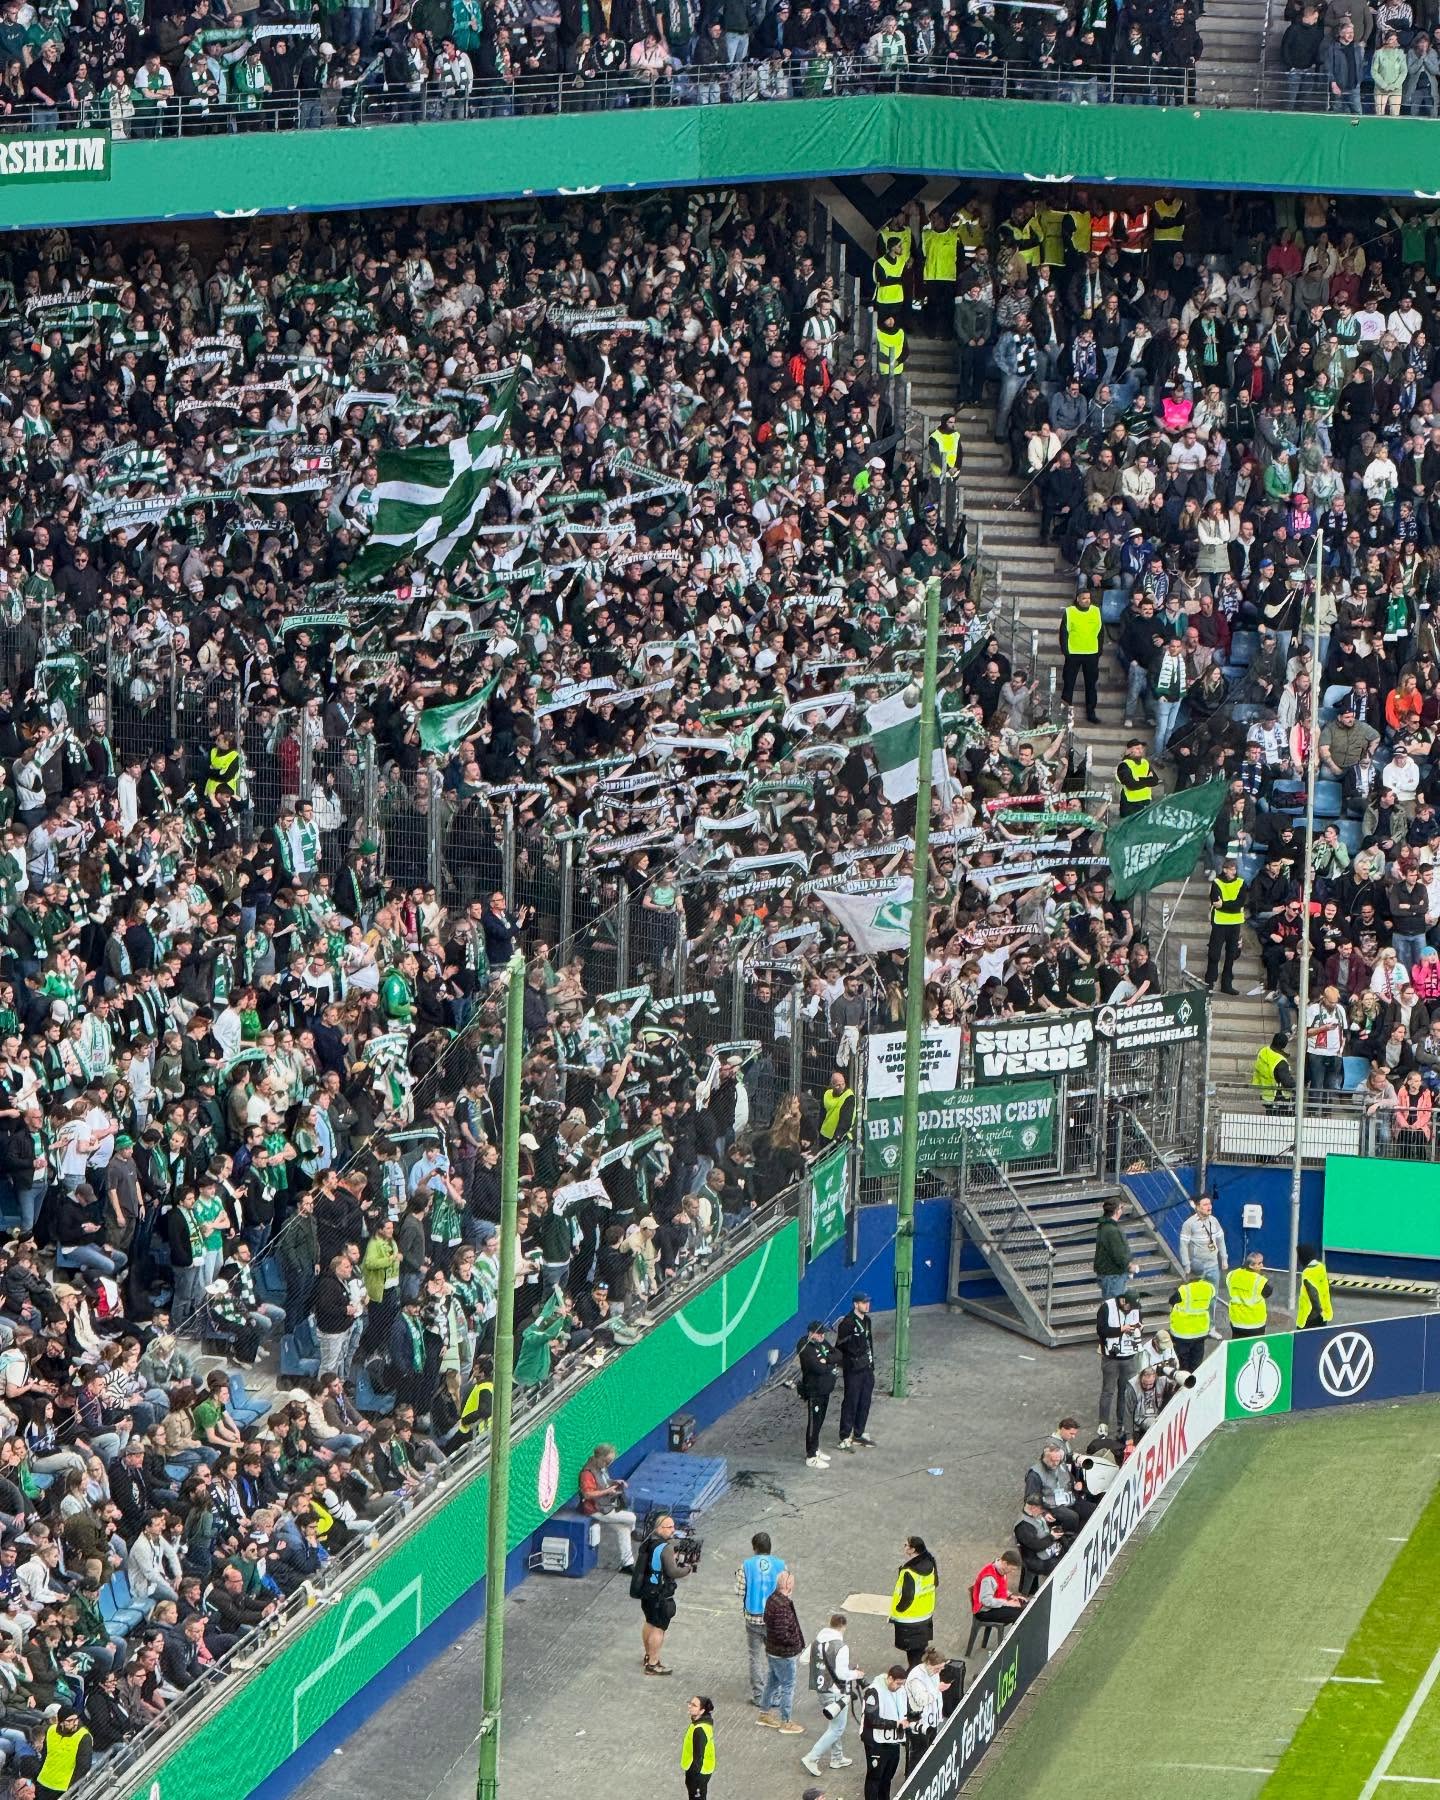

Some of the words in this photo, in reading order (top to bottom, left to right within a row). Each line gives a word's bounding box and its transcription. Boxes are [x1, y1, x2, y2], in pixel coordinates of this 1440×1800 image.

[1117, 1002, 1164, 1020] FORZA
[1117, 1016, 1176, 1035] WERDER
[983, 1043, 1088, 1077] VERDE
[896, 1072, 930, 1083] TM
[867, 1118, 890, 1140] HB
[893, 1104, 1002, 1136] NRDHESSEN
[1005, 1097, 1052, 1123] CREW
[996, 1644, 1019, 1714] los!
